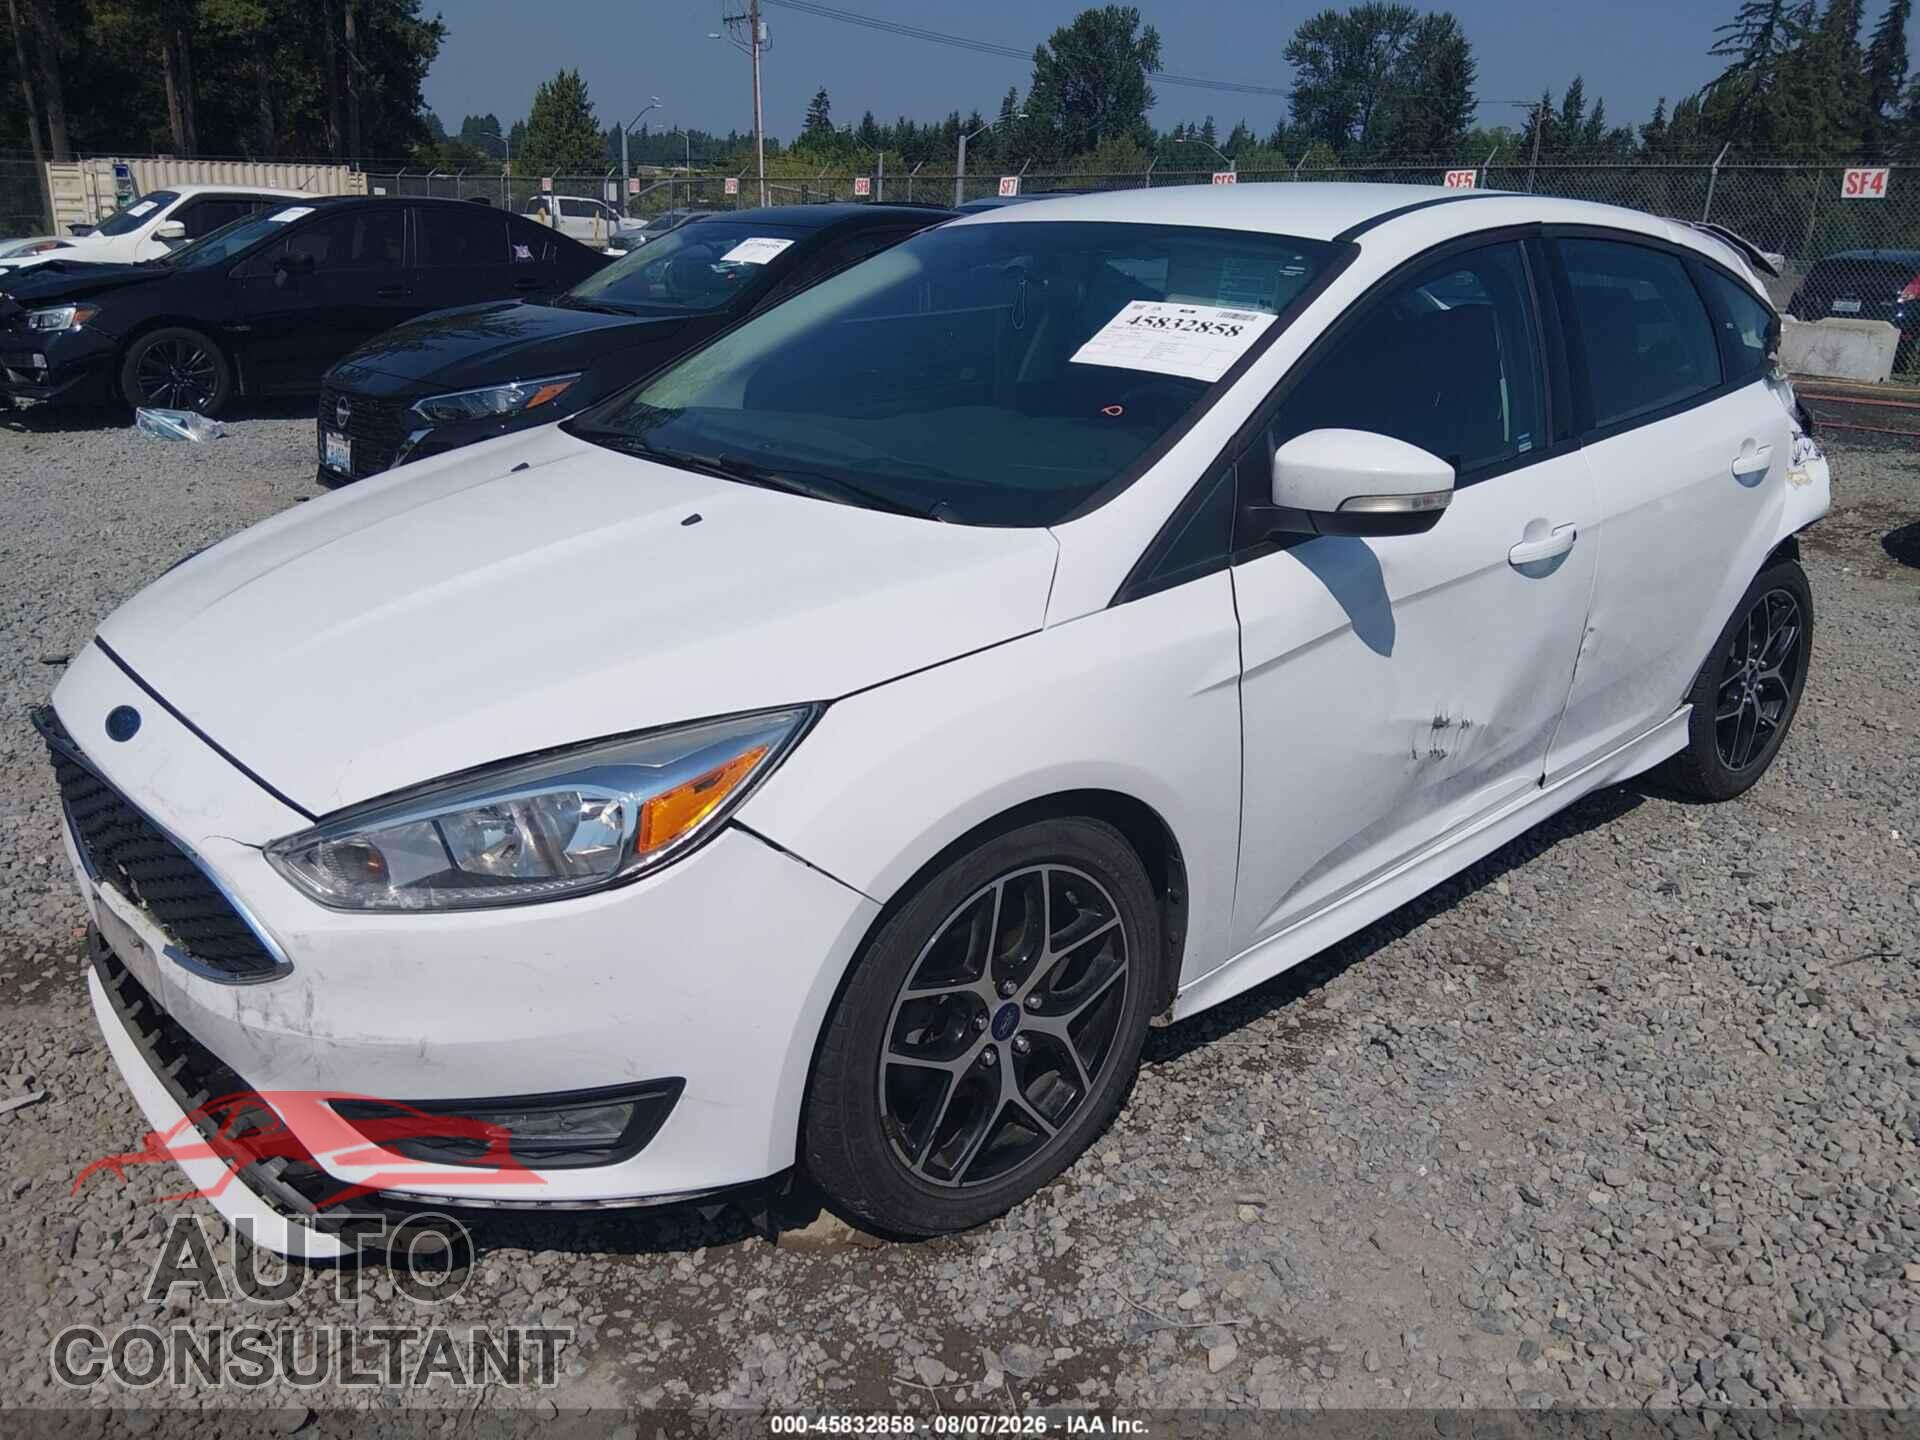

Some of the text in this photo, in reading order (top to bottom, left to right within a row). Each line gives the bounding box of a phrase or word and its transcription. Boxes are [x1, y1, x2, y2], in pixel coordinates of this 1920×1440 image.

[1001, 179, 1016, 194] SF7
[1447, 172, 1473, 188] SF5
[1846, 171, 1886, 195] SF4
[1126, 315, 1244, 337] 45832858
